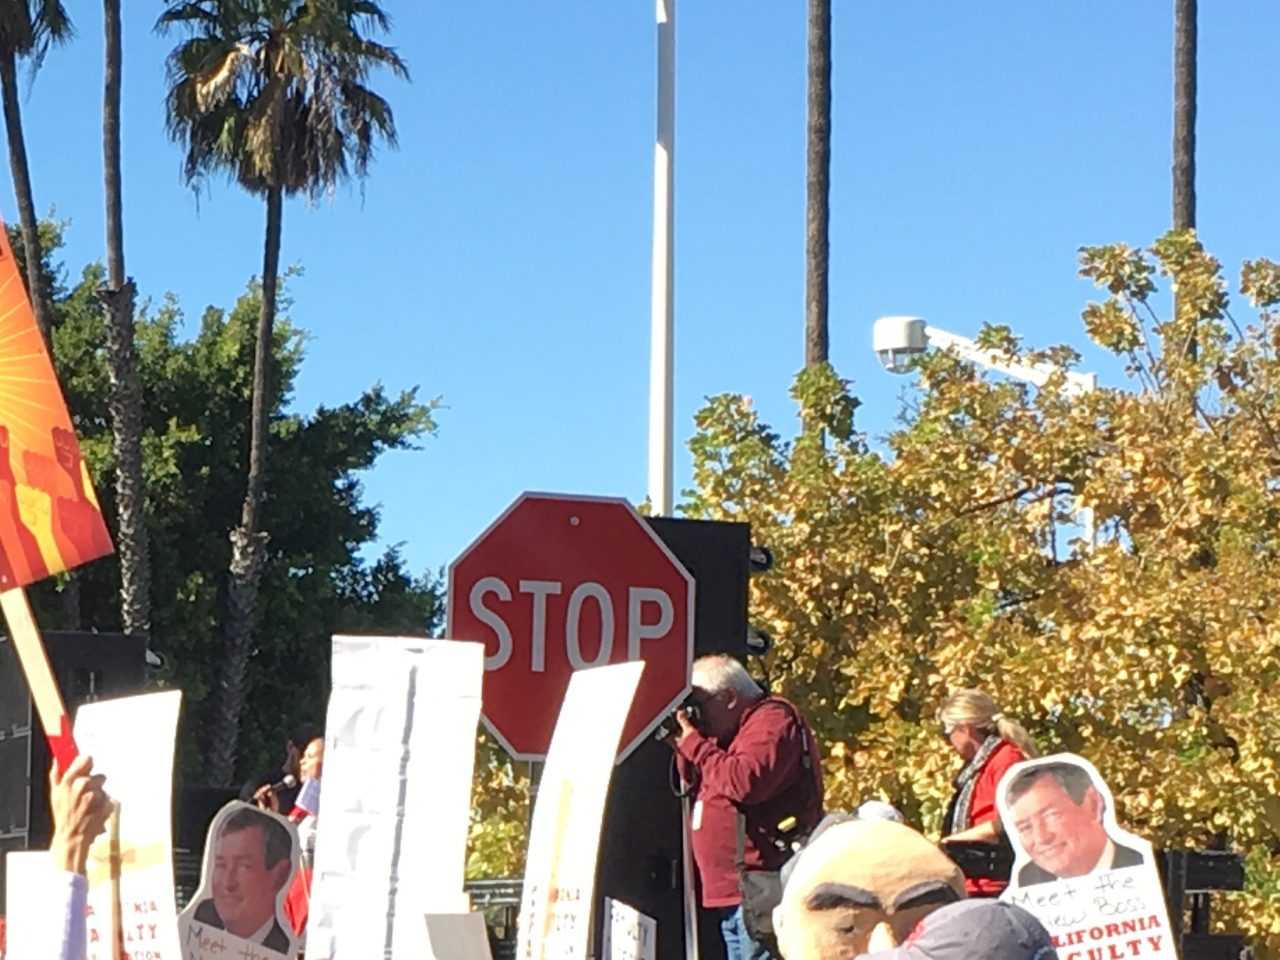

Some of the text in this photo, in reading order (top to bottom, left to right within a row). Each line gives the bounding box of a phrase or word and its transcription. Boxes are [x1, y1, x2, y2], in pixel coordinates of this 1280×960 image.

[469, 576, 675, 673] STOP
[1011, 873, 1137, 909] Meet the
[1093, 896, 1148, 918] Boss
